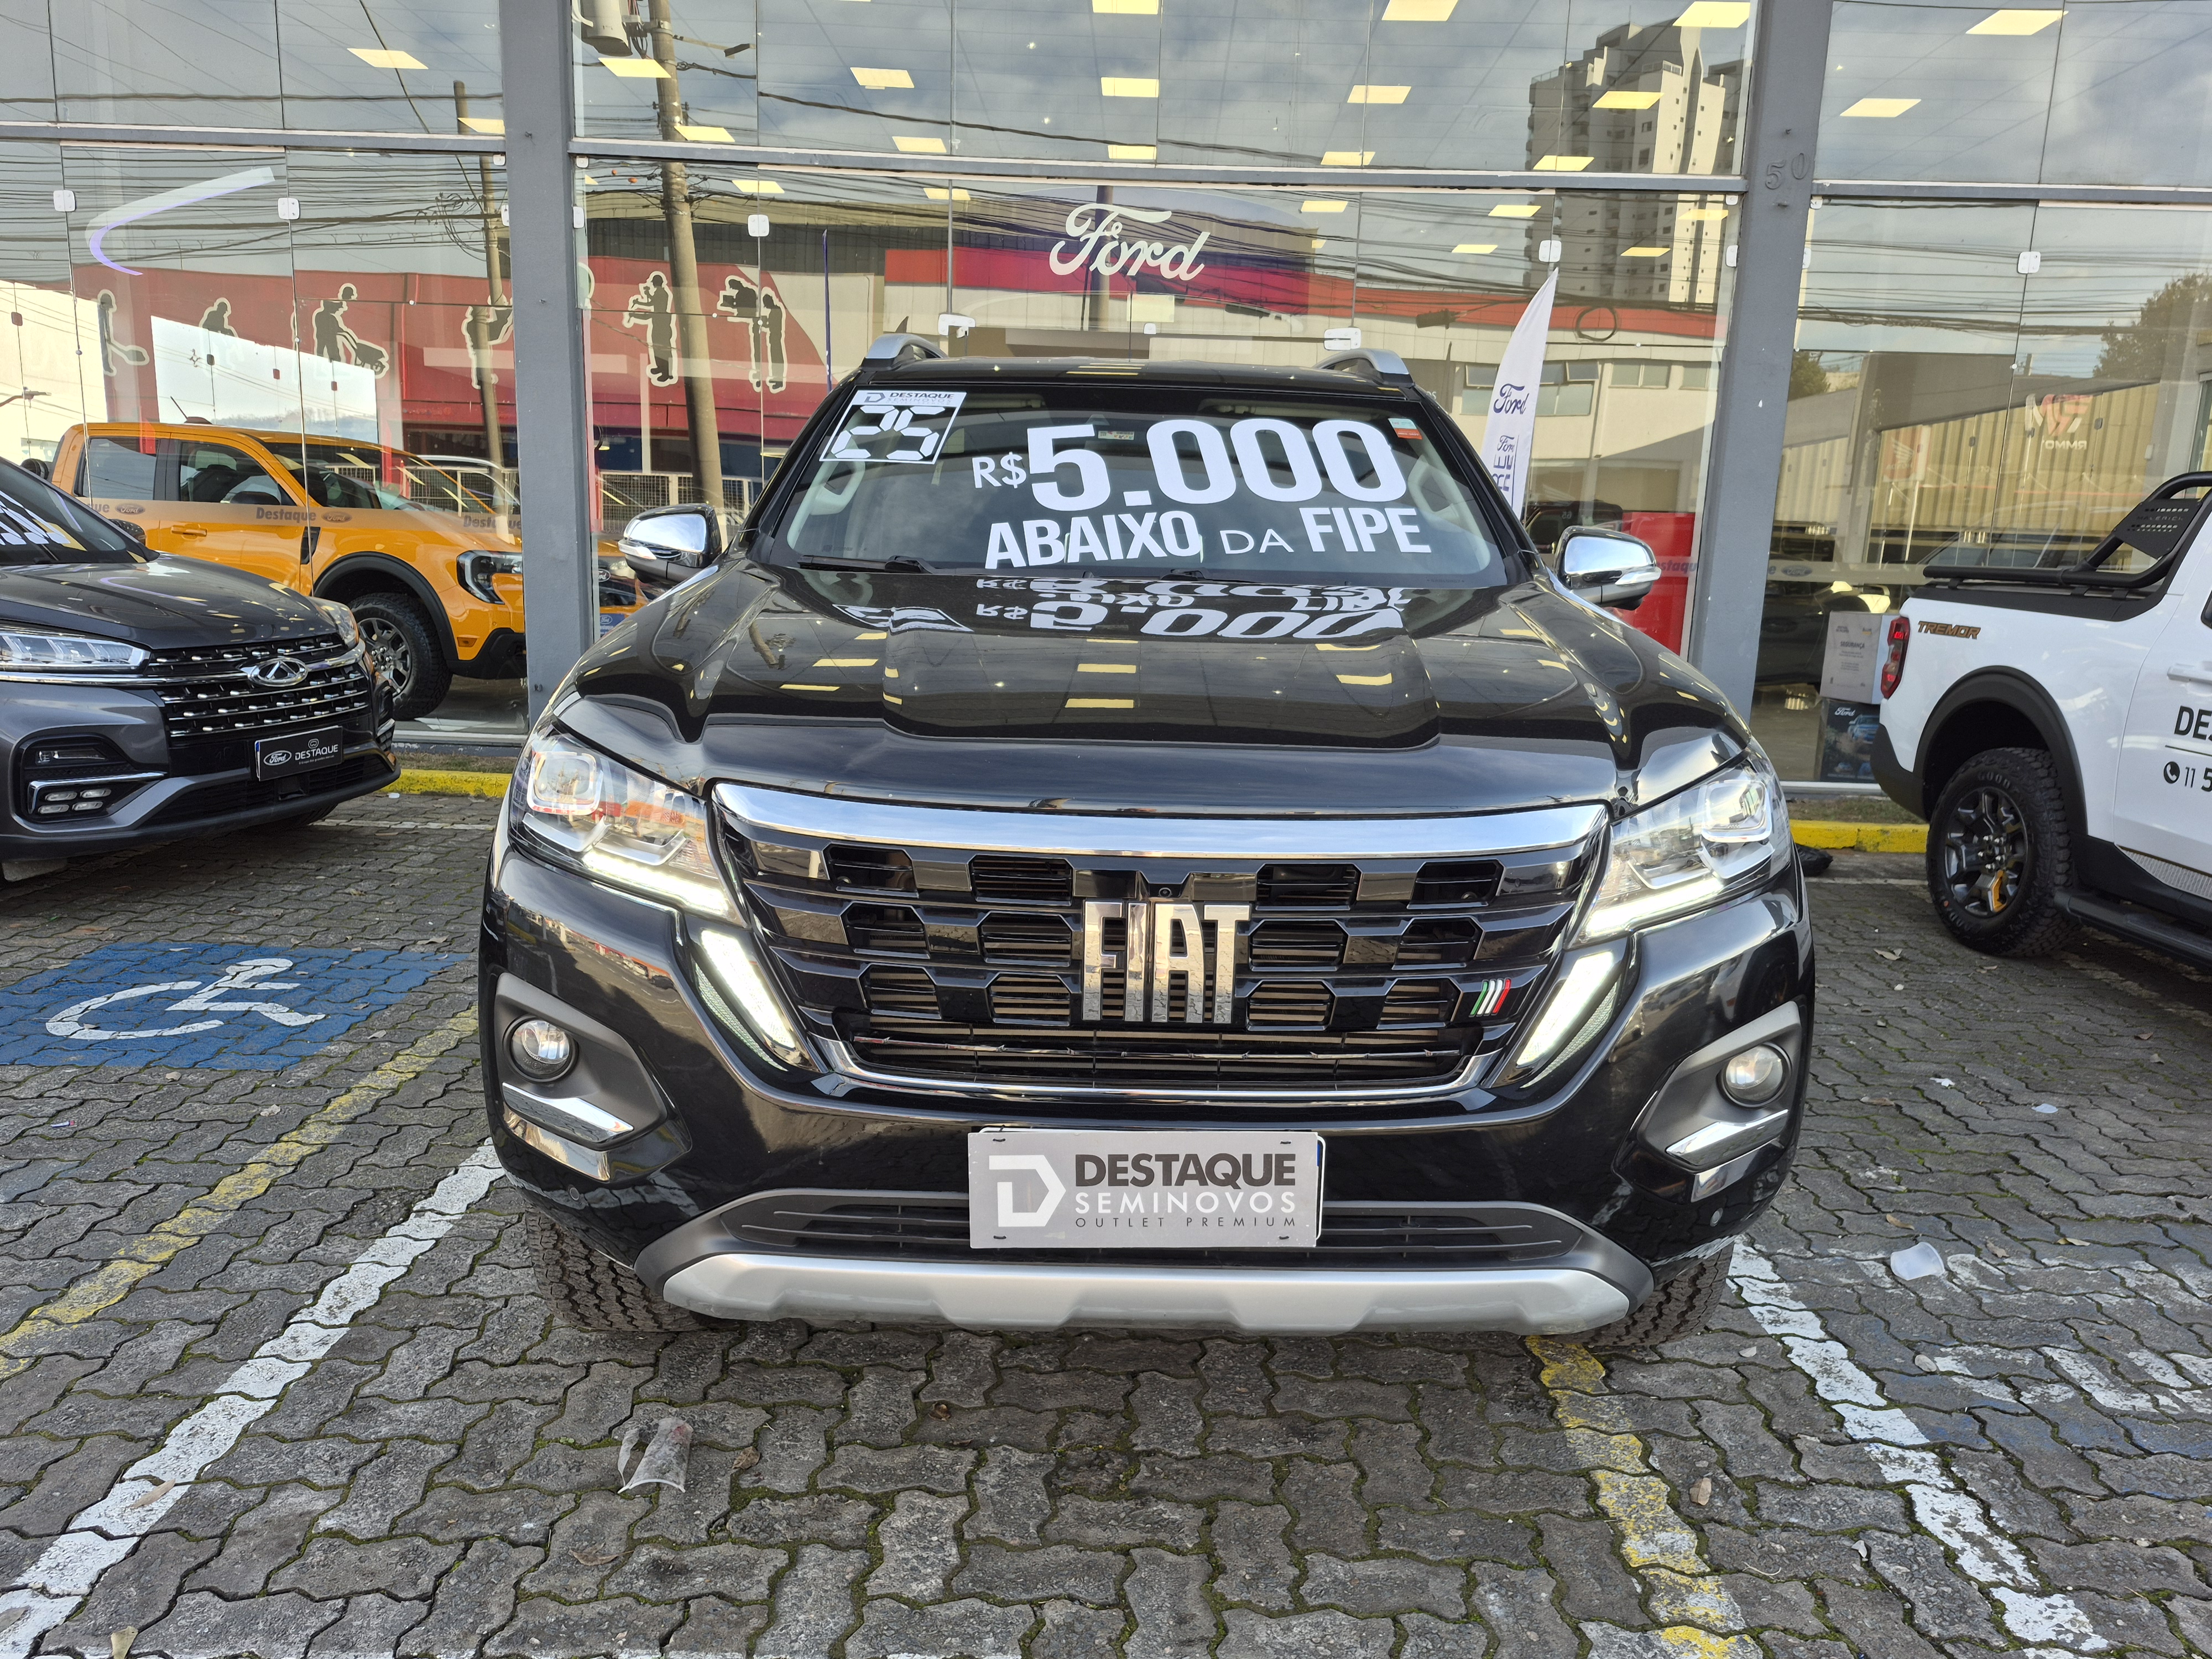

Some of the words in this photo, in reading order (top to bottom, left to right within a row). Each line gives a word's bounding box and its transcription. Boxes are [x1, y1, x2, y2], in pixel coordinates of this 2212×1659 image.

[1049, 203, 1211, 281] Ford
[1493, 383, 1530, 415] Ford
[831, 405, 946, 461] 25
[1497, 435, 1515, 452] For
[257, 507, 316, 523] Destaque
[463, 515, 521, 530] Destaue
[984, 510, 1202, 569] ABAIXO
[1220, 529, 1295, 554] DA
[1300, 507, 1432, 553] FIPE
[1918, 620, 1981, 640] TREMOR
[1834, 706, 1856, 717] Ford
[2174, 705, 2212, 742] DE
[269, 753, 286, 764] Ford
[295, 744, 338, 761] DESTAQUE
[2185, 766, 2196, 788] 11
[1082, 901, 1251, 1023] FIAT
[1075, 1153, 1296, 1189] DESTAQUE
[1075, 1191, 1296, 1214] SEMINOVOS
[1076, 1217, 1164, 1227] OUTLET
[1186, 1217, 1296, 1227] PREMIUM
